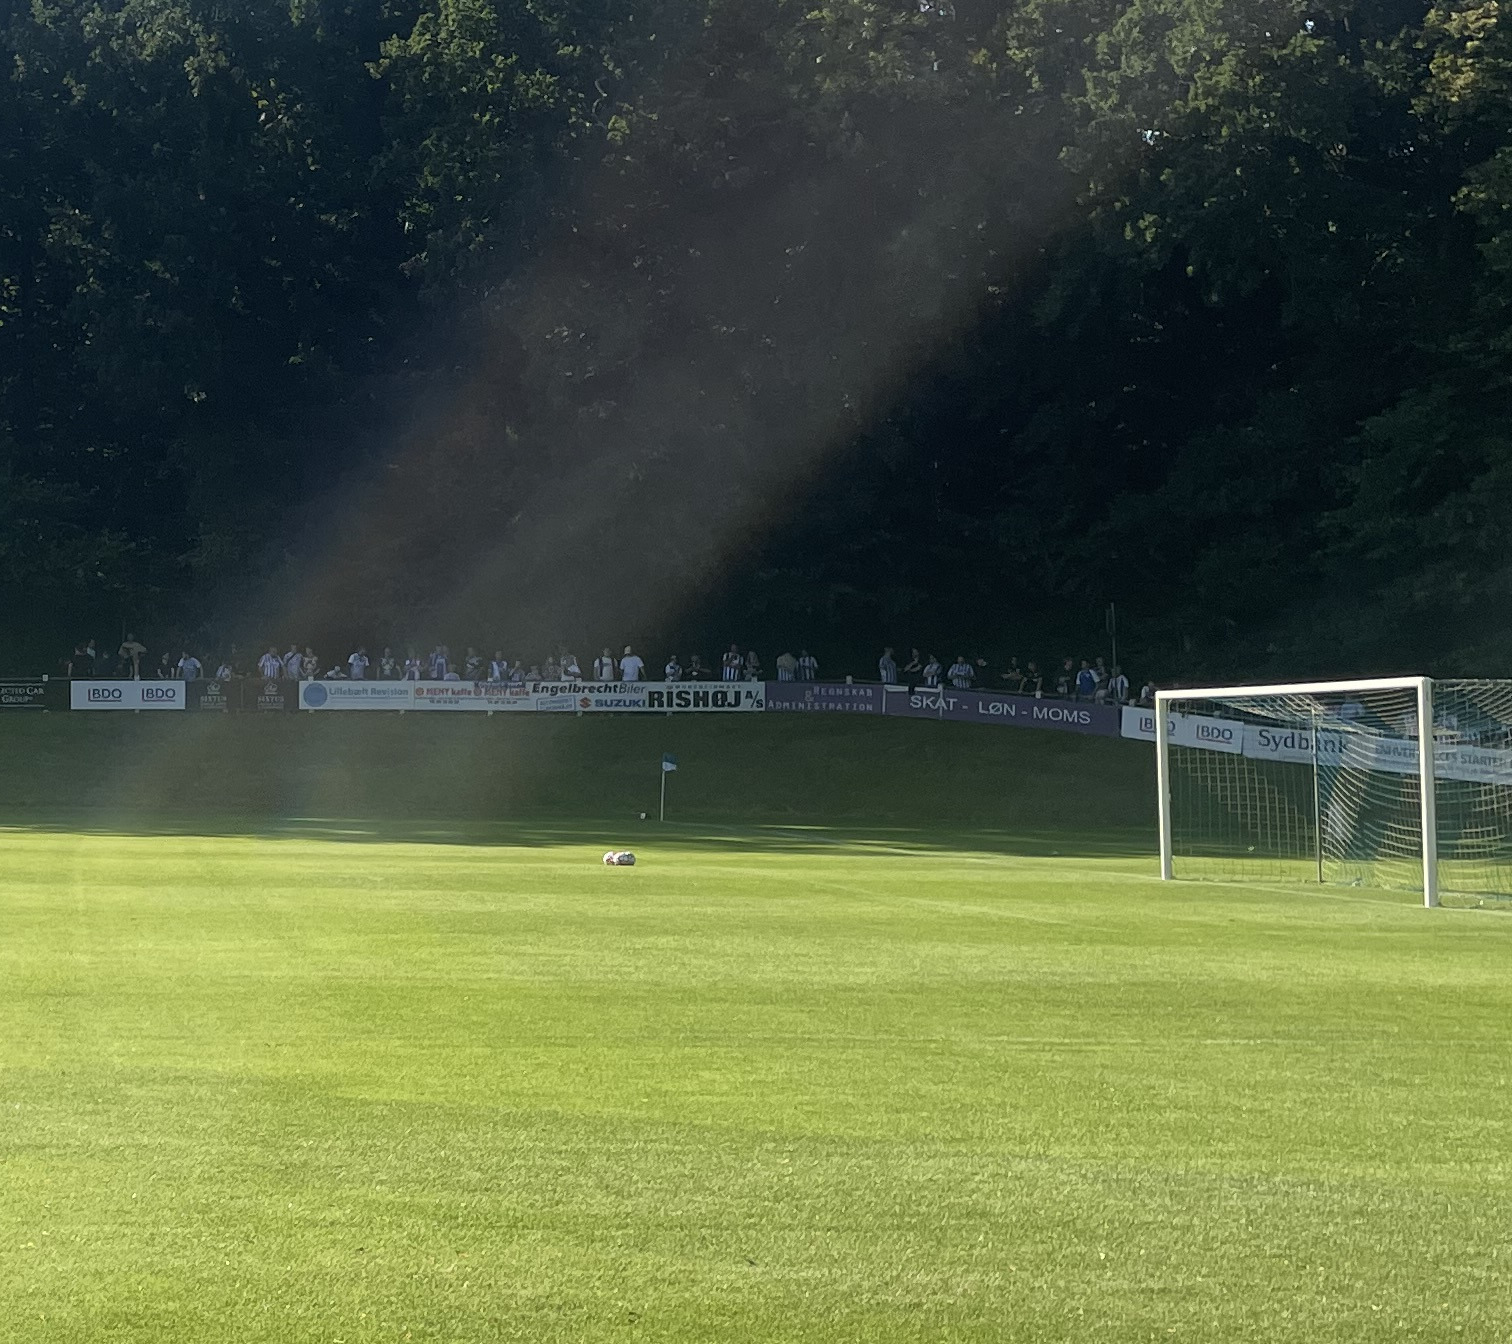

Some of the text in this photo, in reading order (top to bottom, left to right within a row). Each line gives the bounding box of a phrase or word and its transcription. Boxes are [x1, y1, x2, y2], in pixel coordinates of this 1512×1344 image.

[92, 688, 123, 700] BDO
[146, 688, 177, 699] BDO
[370, 687, 409, 696] Revision
[804, 691, 814, 702] &
[594, 699, 646, 707] SUZUKI
[648, 689, 764, 709] RISHØJ A/S
[910, 695, 958, 711] SKAT
[978, 701, 1016, 717] LØN
[1033, 706, 1091, 724] MOMS
[1201, 725, 1233, 741] BDO
